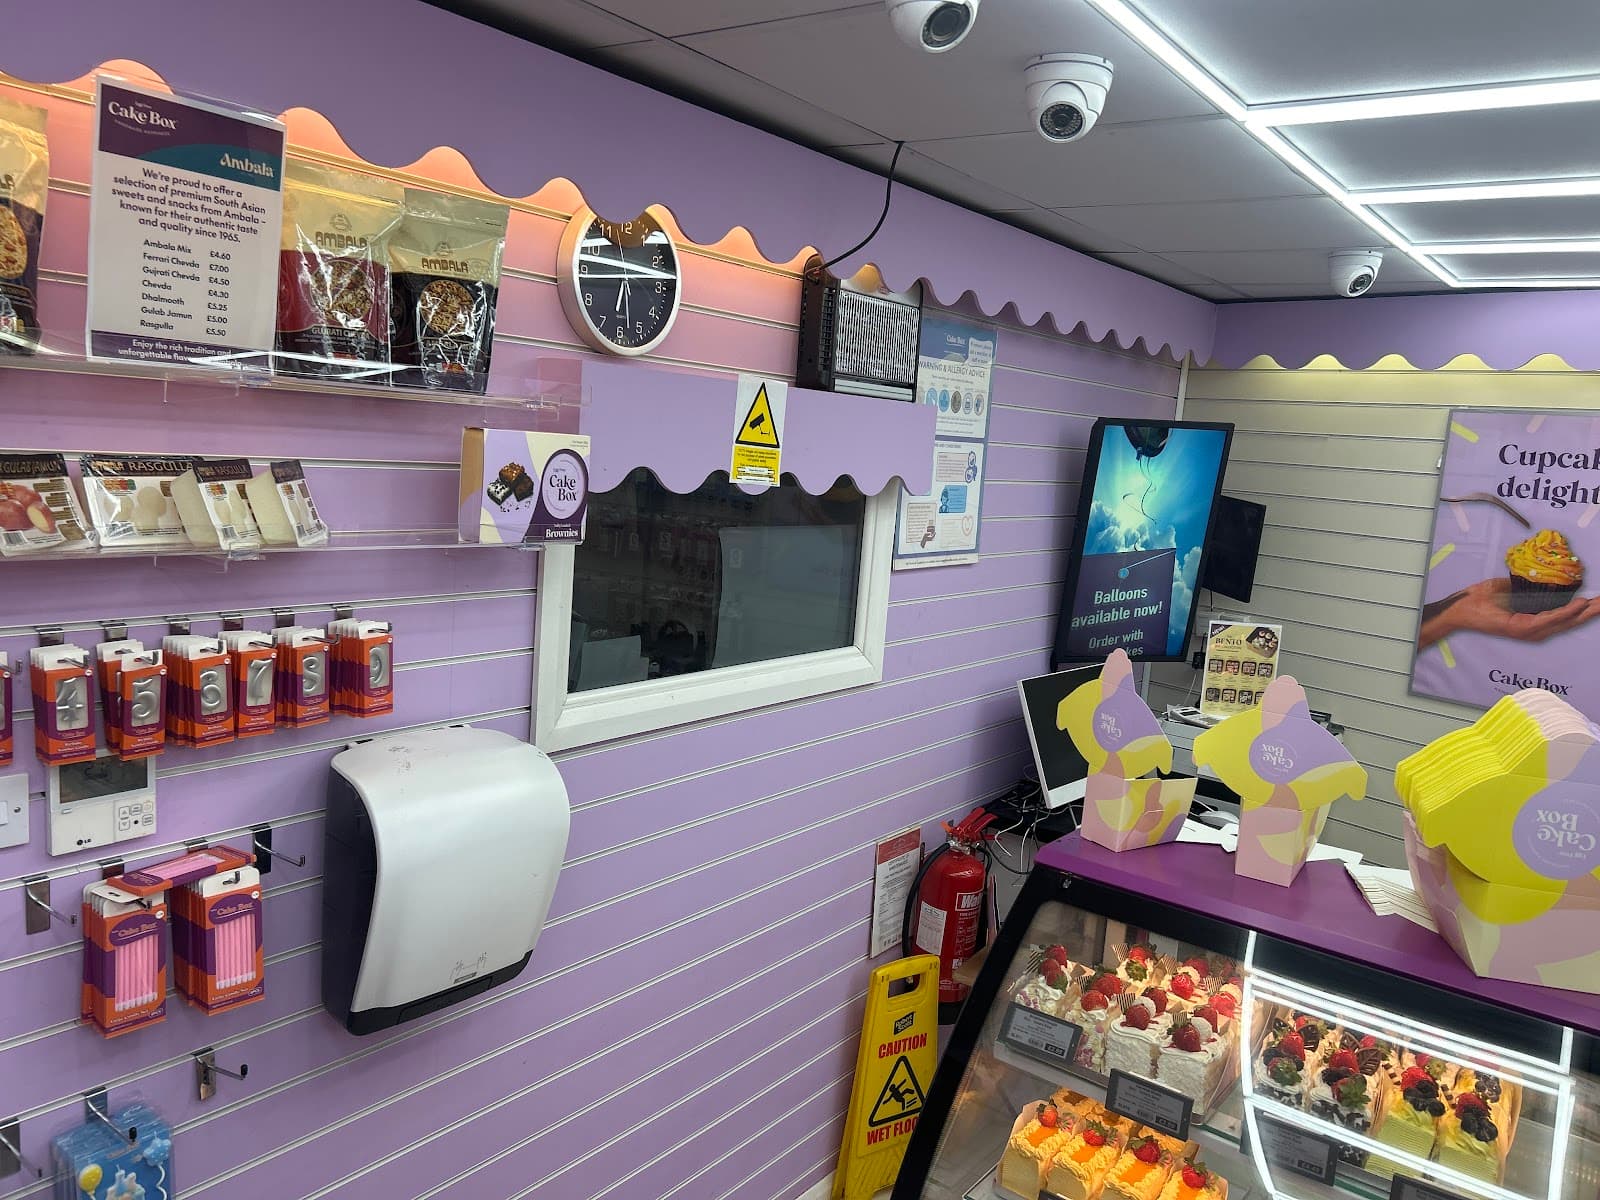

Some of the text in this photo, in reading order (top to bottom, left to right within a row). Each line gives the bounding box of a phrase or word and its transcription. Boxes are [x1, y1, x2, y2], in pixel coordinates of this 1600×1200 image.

[108, 101, 177, 129] Cake Box
[220, 153, 274, 178] Ambala
[143, 167, 243, 198] We're proud to offer a
[113, 175, 266, 215] selection of premium South Asian
[111, 187, 144, 202] sweets
[147, 195, 166, 206] and
[168, 198, 199, 212] snacks
[201, 204, 222, 217] from
[224, 210, 260, 225] Ambala
[120, 200, 258, 235] known for their authentic taste
[138, 216, 241, 243] and quality since 1965.
[600, 223, 612, 238] 11
[621, 221, 633, 234] 12
[315, 231, 368, 249] AMBALA
[143, 238, 231, 261] Ambala Mix £4.60
[587, 244, 600, 256] 10
[143, 252, 229, 273] Ferrari Chevda £7.00
[421, 257, 469, 273] AMBALA
[580, 265, 589, 275] 9
[652, 256, 659, 268] 2
[142, 266, 230, 287] Gujrati Chevda £4.50
[142, 279, 229, 299] Chevda £4.30
[655, 281, 662, 294] 3
[142, 292, 228, 312] Dhalmooth £5.25
[585, 293, 593, 306] 8
[141, 306, 228, 324] Gulab Jamun £5.00
[649, 306, 656, 317] 4
[140, 319, 227, 337] Rasgulla £5.50
[600, 315, 607, 328] 7
[636, 321, 643, 334] 5
[616, 327, 624, 339] 6
[118, 348, 172, 362] unforgettable
[132, 339, 231, 357] Enjoy the rich tradition and
[947, 365, 968, 376] ALLERGY
[128, 460, 194, 473] RASGULLA
[549, 474, 577, 492] Cake
[558, 489, 577, 502] Box
[545, 527, 578, 538] Brownies
[1094, 588, 1148, 605] Balloons
[1071, 601, 1163, 629] available now!
[1088, 629, 1144, 649] Order with
[1215, 637, 1242, 646] BENTO
[1489, 669, 1570, 696] Cake Box
[1261, 743, 1287, 758] Box
[1262, 752, 1294, 771] Cake
[1536, 809, 1579, 832] Box
[1536, 824, 1596, 852] Cake
[878, 1033, 928, 1059] CAUTION
[867, 1125, 892, 1145] WET
